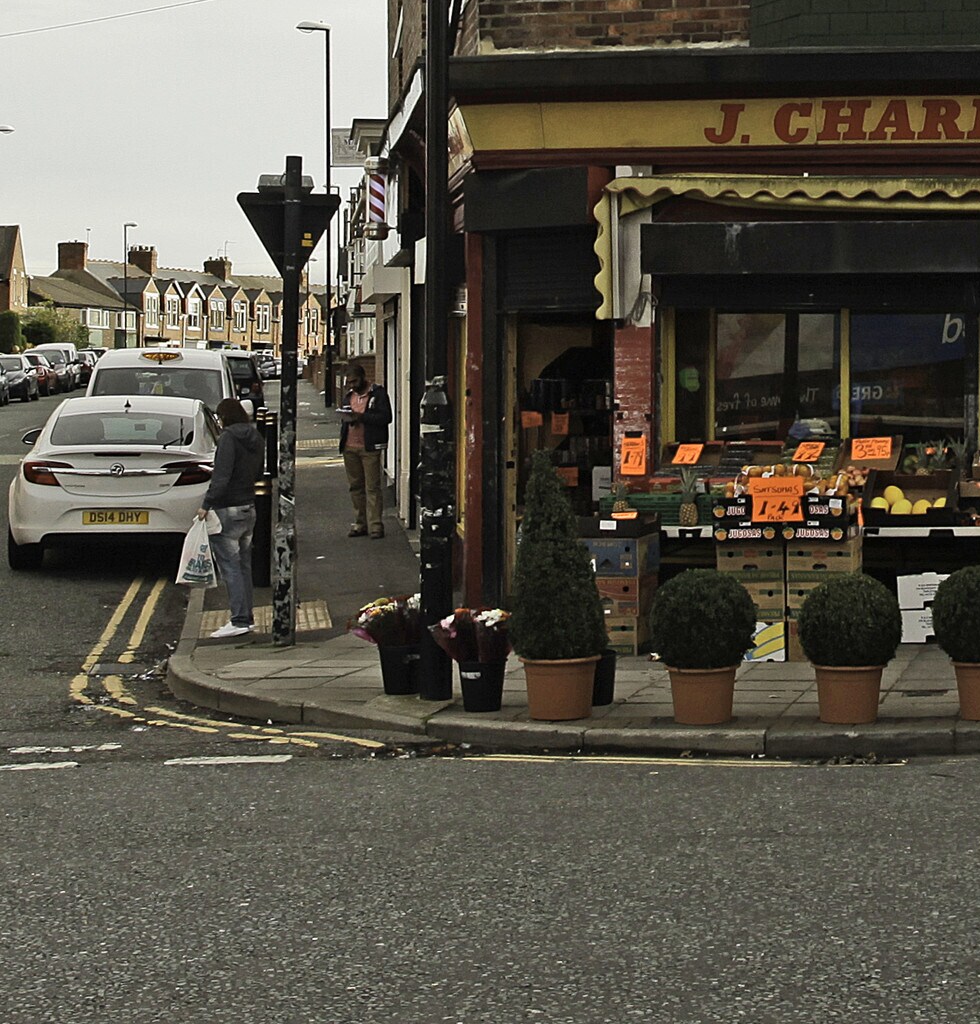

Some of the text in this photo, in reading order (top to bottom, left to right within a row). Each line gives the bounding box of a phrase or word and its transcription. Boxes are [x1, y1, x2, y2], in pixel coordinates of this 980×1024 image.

[704, 103, 750, 144] J.
[854, 444, 867, 458] 3
[808, 505, 829, 515] OSAS
[89, 511, 141, 523] DS14 DHY
[728, 528, 762, 539] JUGOSAS
[795, 528, 830, 539] JUGOSAS
